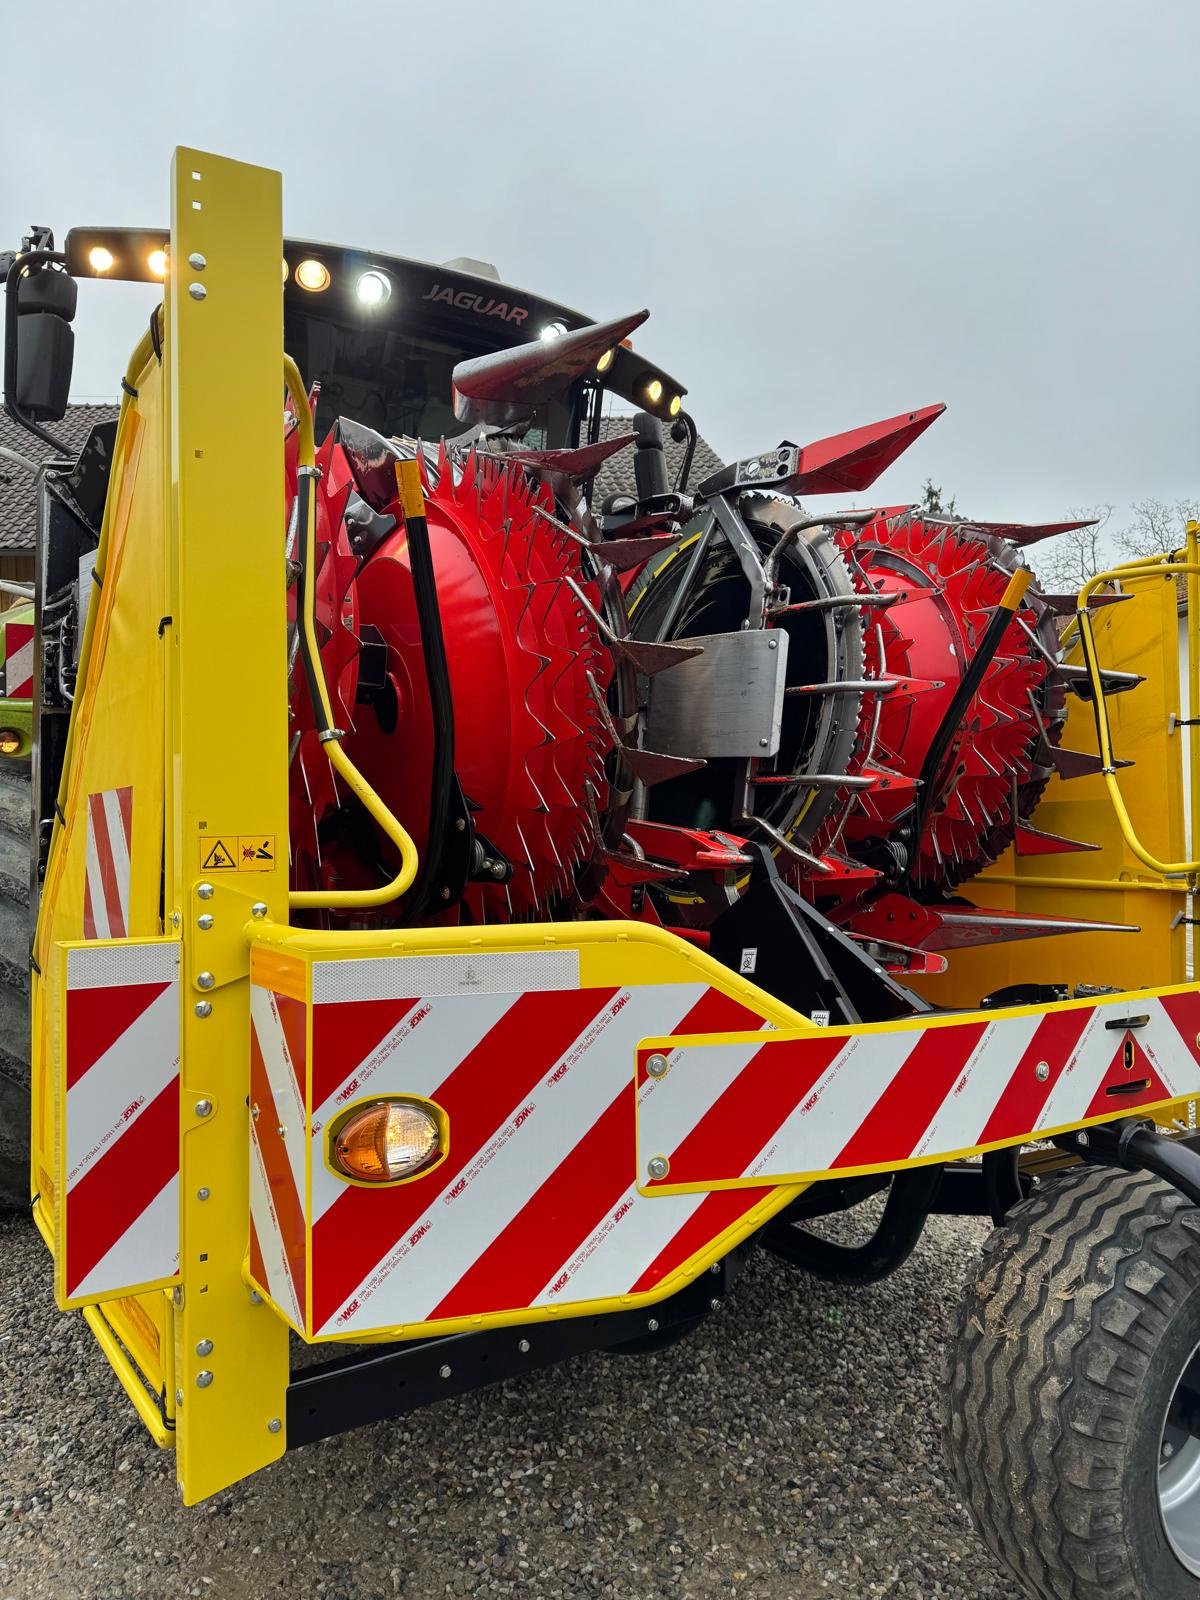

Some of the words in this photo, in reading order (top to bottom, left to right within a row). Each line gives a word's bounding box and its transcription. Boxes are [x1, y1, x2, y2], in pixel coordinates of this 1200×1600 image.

[422, 284, 529, 326] JAGUAR
[612, 998, 626, 1016] WGF
[408, 1009, 427, 1029] WGF
[551, 1063, 567, 1082] WGF
[341, 1079, 358, 1099] WGF
[124, 1101, 140, 1121] WGF
[513, 1108, 531, 1128] WGF
[449, 1178, 466, 1198] WGF
[466, 1169, 474, 1177] DIN
[613, 1204, 629, 1223] WGF
[408, 1226, 427, 1247] WGF
[552, 1272, 568, 1292] WGF
[341, 1299, 358, 1320] WGF
